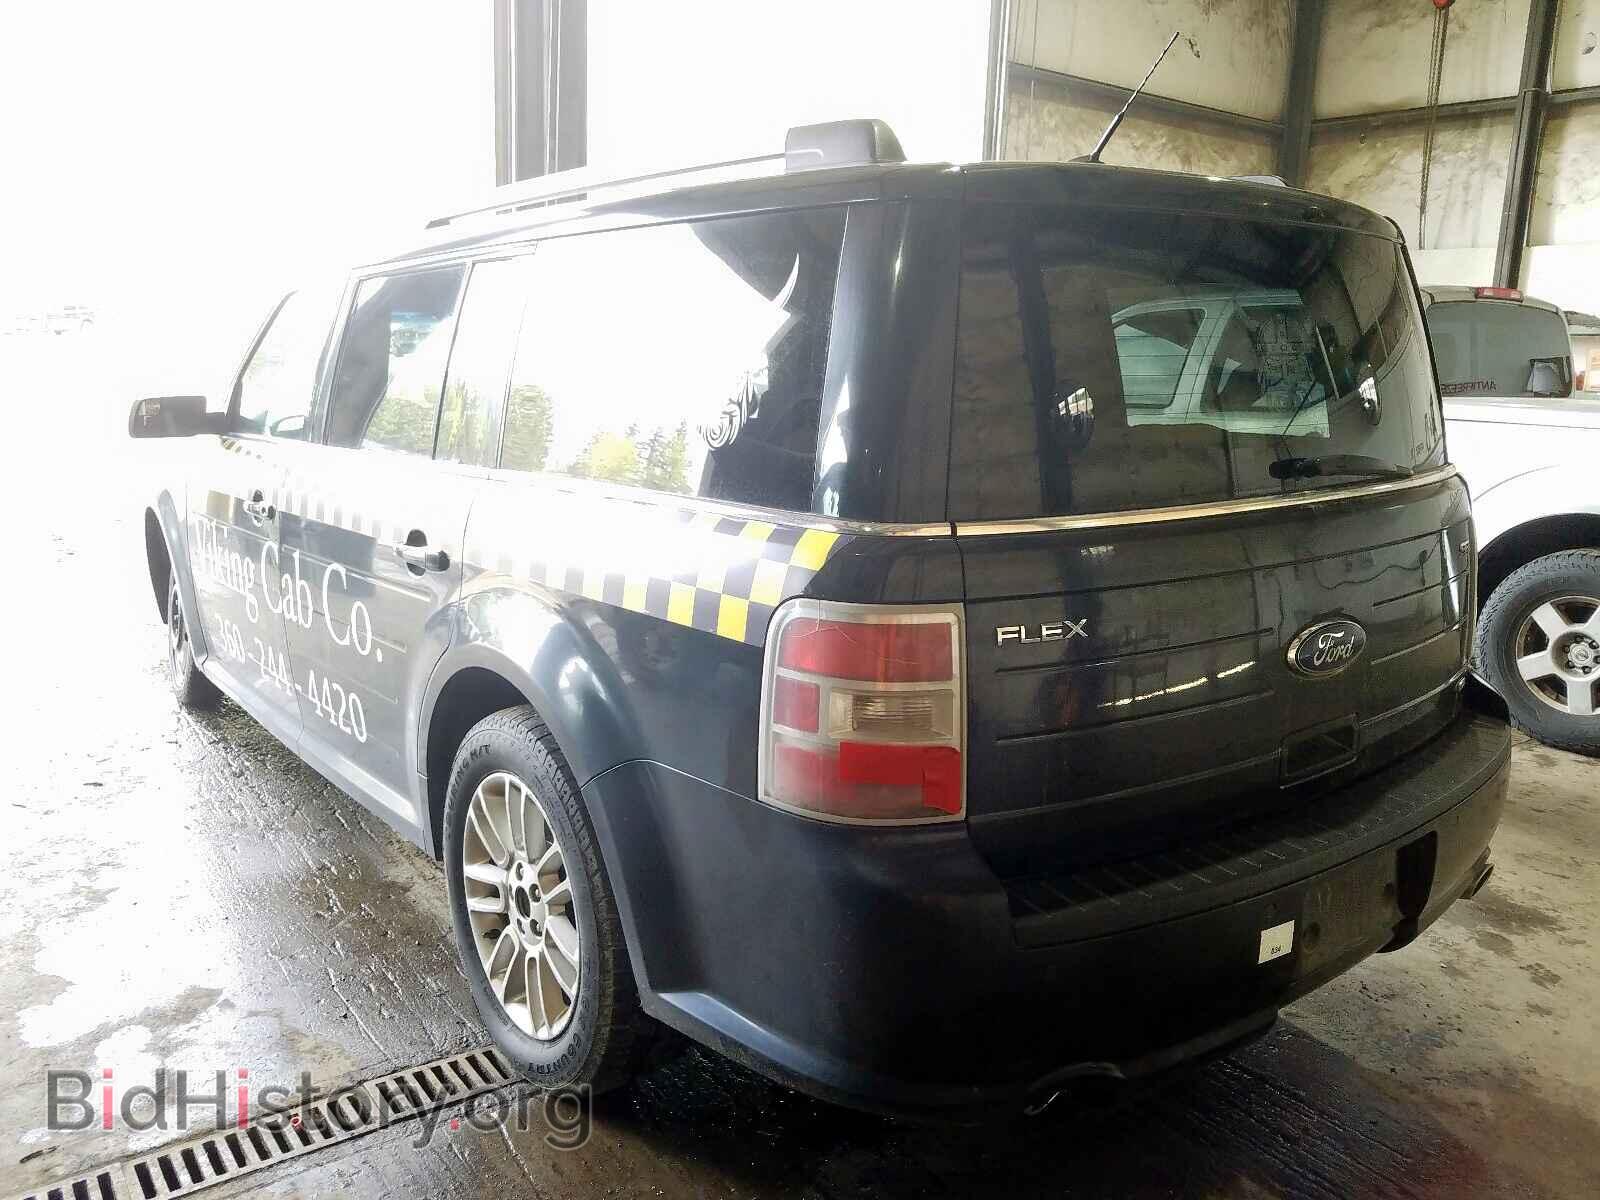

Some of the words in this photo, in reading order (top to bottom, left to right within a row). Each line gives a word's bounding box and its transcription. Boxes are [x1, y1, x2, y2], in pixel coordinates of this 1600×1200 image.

[260, 540, 313, 629] Cab
[323, 562, 382, 662] Co.
[996, 619, 1089, 647] FLEX
[1313, 630, 1355, 666] Ford
